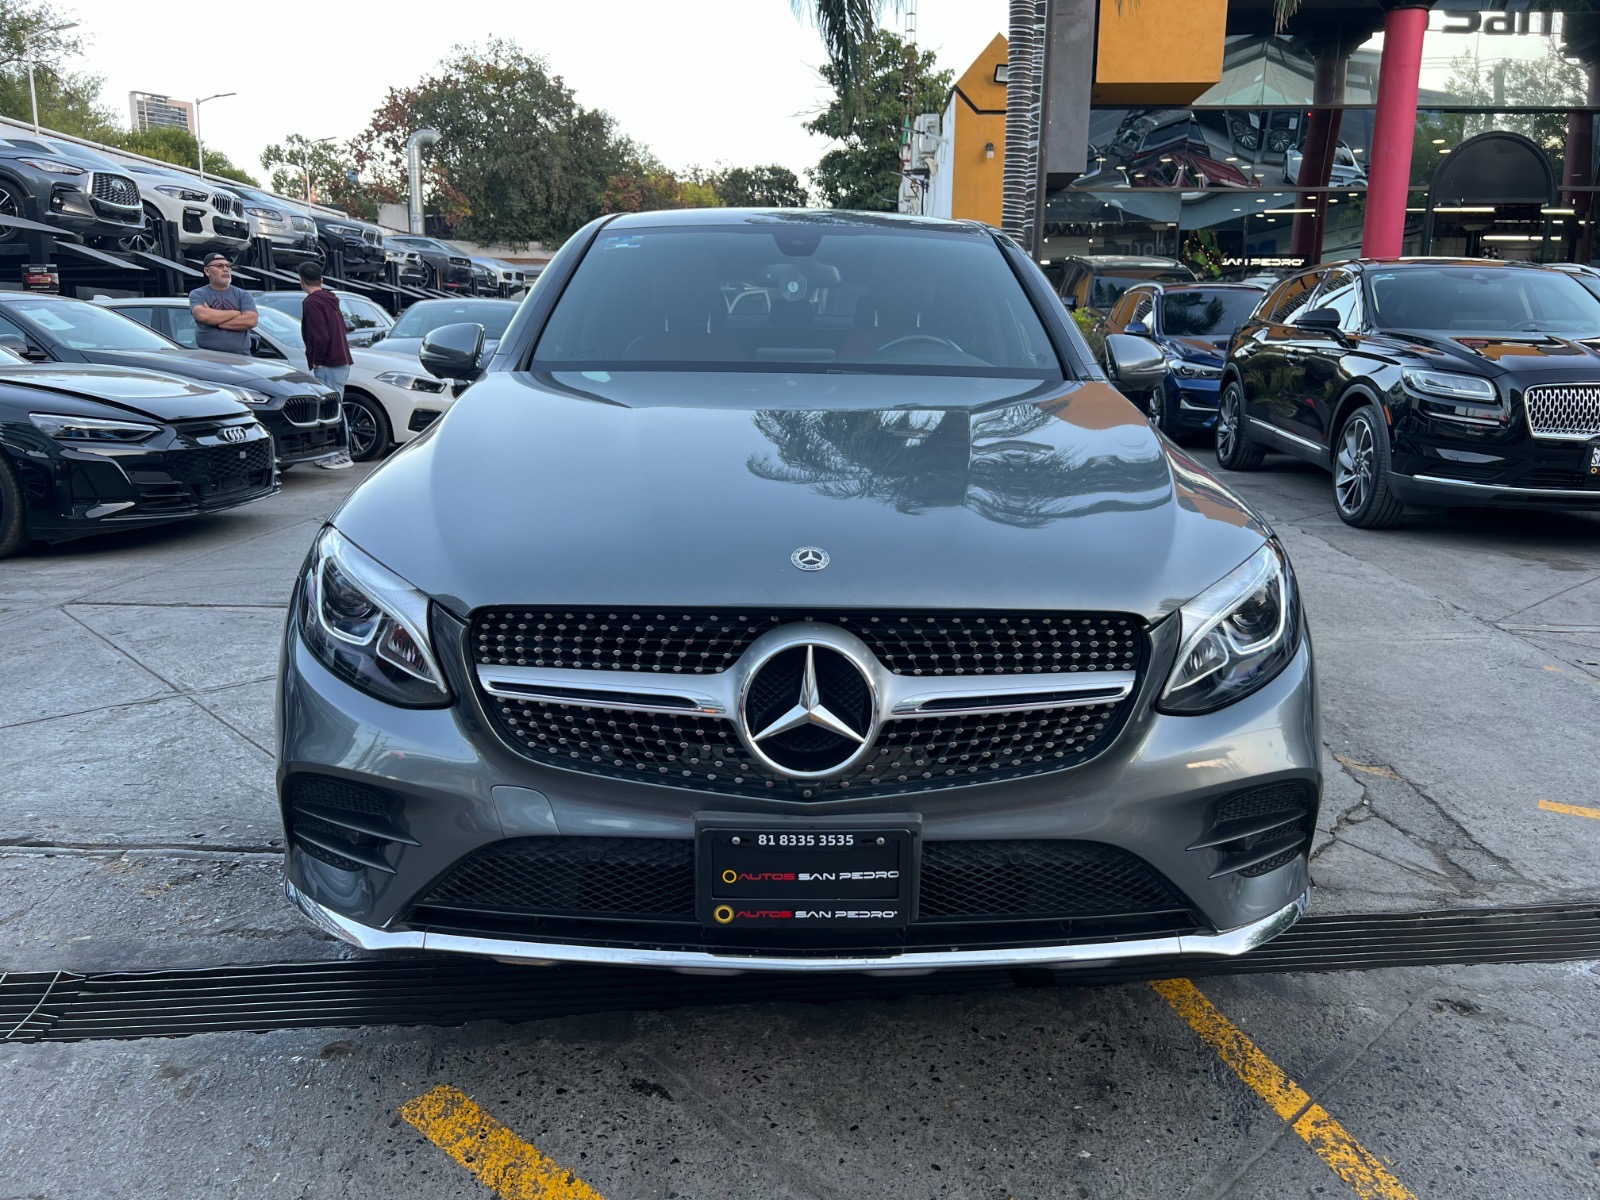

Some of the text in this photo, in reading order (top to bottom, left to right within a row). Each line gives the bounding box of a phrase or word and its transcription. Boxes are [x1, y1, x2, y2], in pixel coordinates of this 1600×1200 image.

[1250, 258, 1303, 266] PEDRO
[758, 834, 854, 846] 81 8335 3535
[738, 870, 900, 881] AUTOS SAN PEDRO
[736, 910, 896, 919] AUTOS SAN PEDRO
